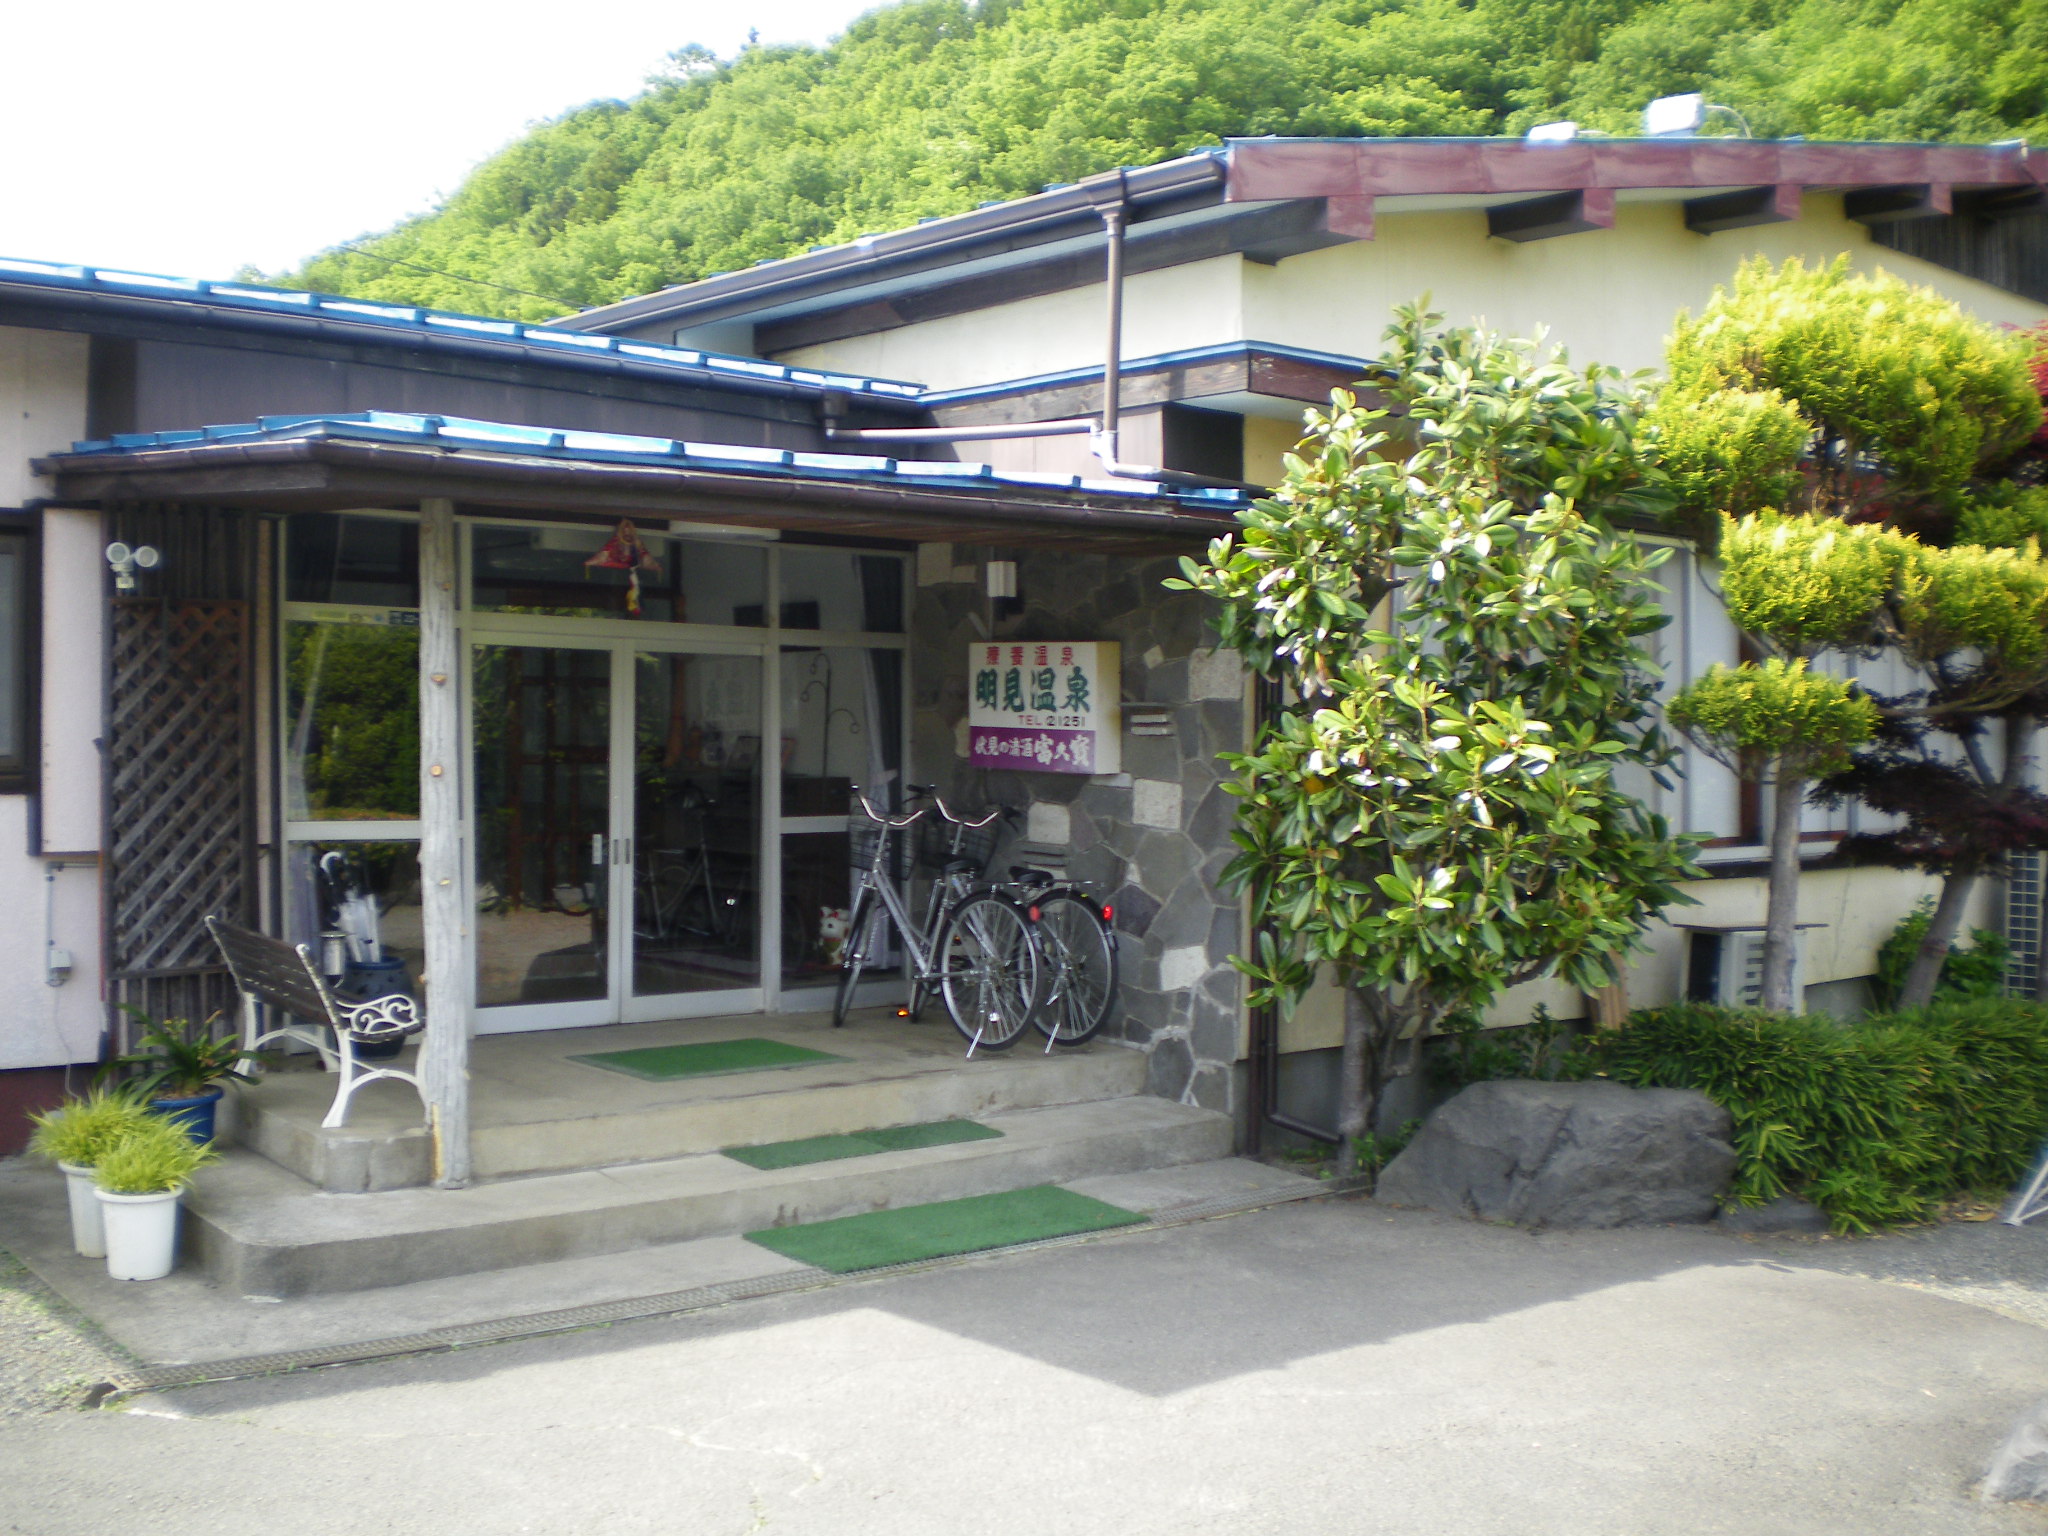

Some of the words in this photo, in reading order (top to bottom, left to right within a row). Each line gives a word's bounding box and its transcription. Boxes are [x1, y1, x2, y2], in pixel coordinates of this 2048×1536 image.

[976, 666, 1091, 712] 明見温泉
[1018, 714, 1042, 726] TEL
